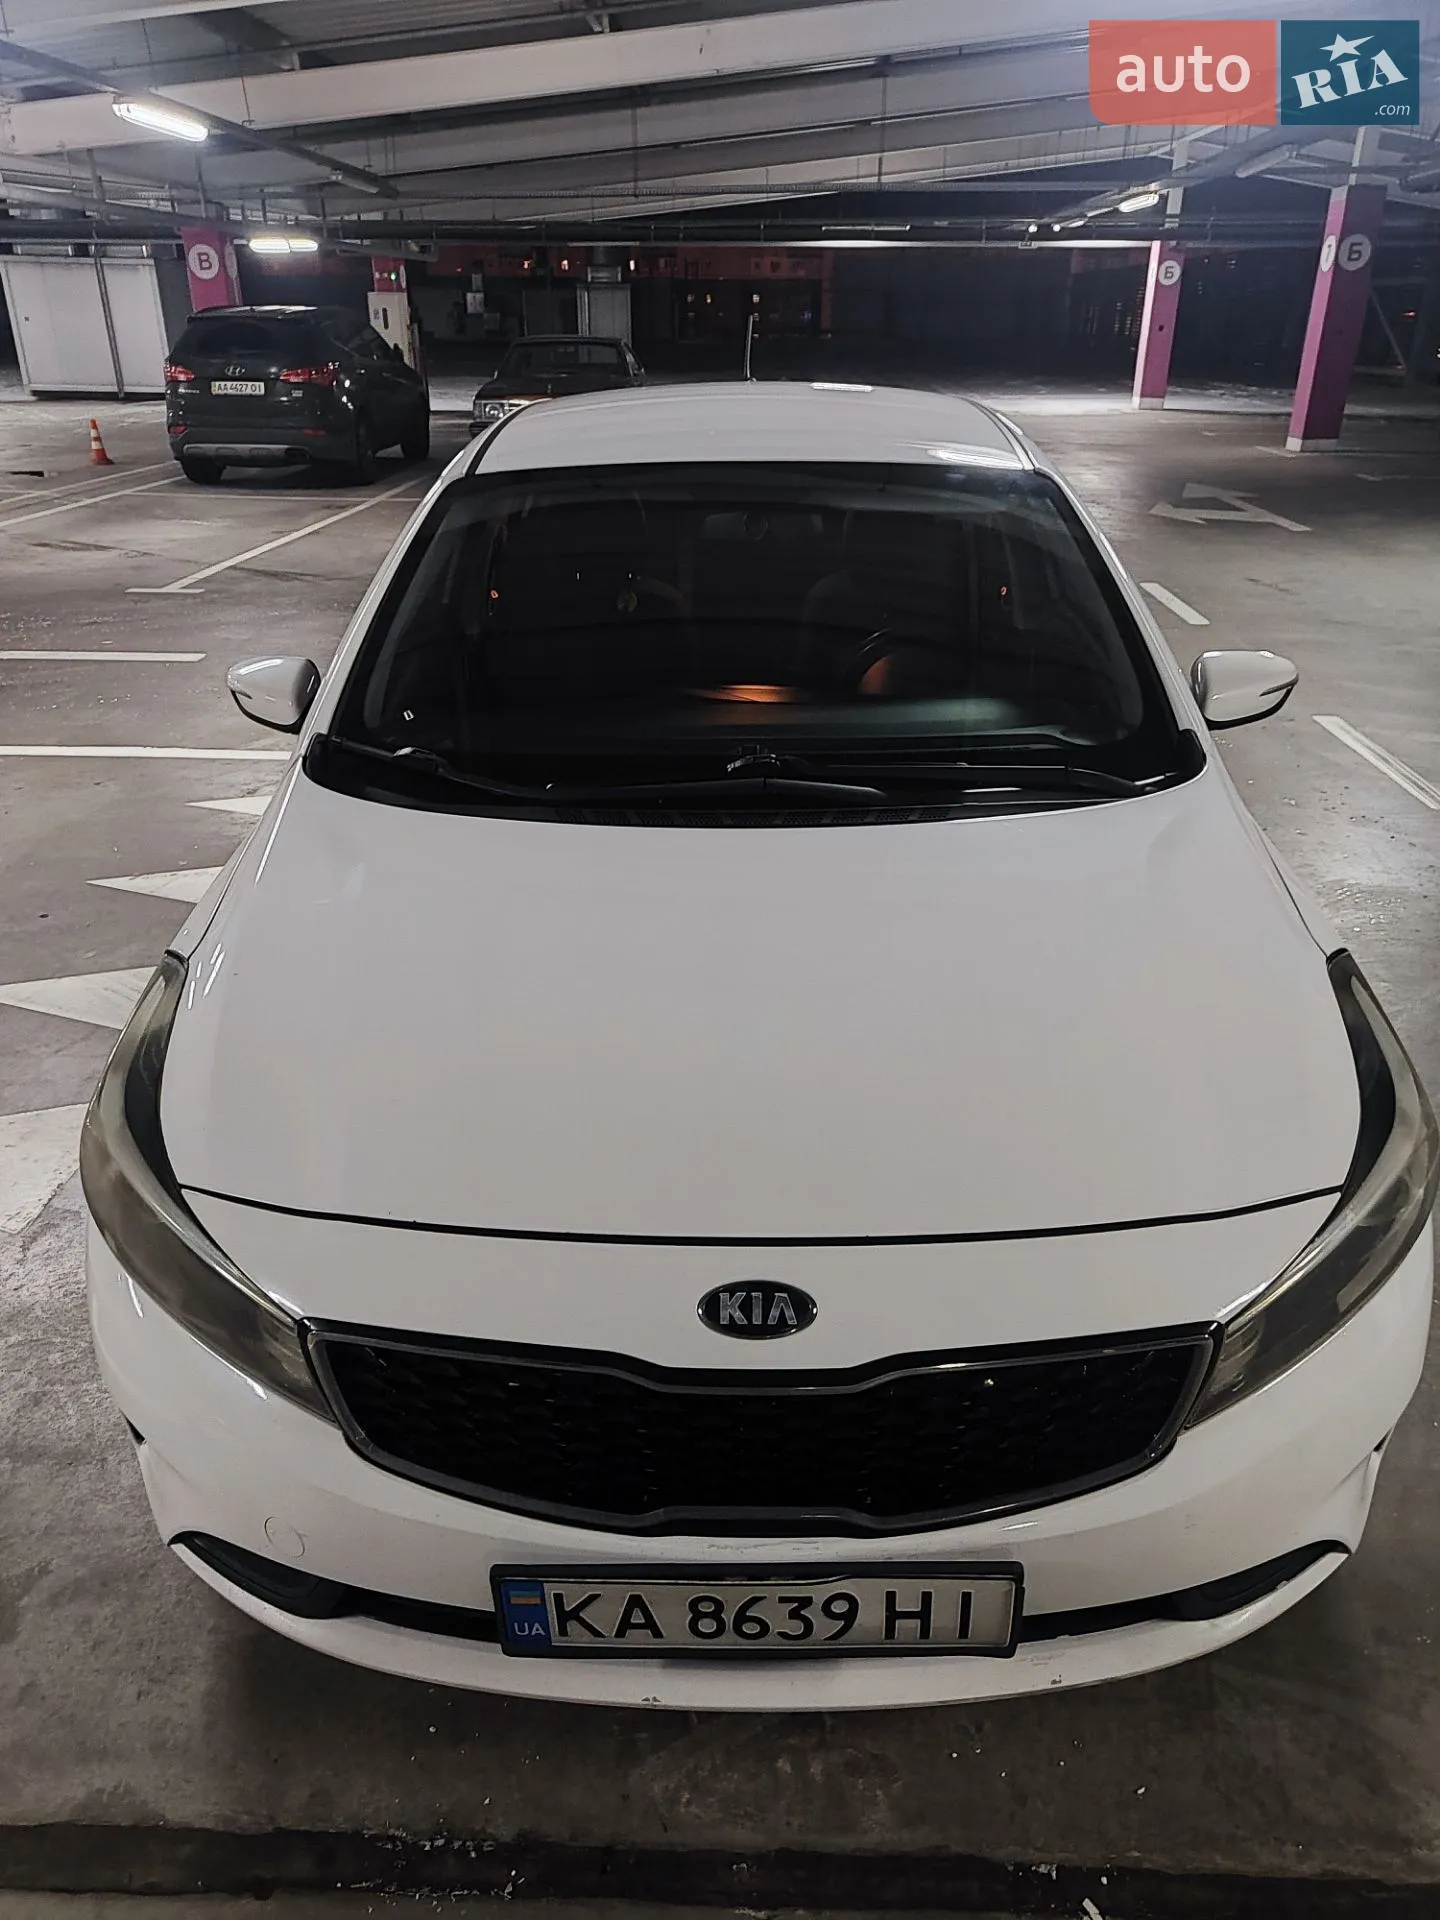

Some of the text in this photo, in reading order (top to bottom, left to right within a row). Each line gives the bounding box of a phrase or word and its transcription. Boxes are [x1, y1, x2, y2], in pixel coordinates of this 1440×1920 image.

[719, 1291, 798, 1325] KIA
[513, 1624, 546, 1638] UA
[552, 1590, 973, 1641] KA 8639 HI
